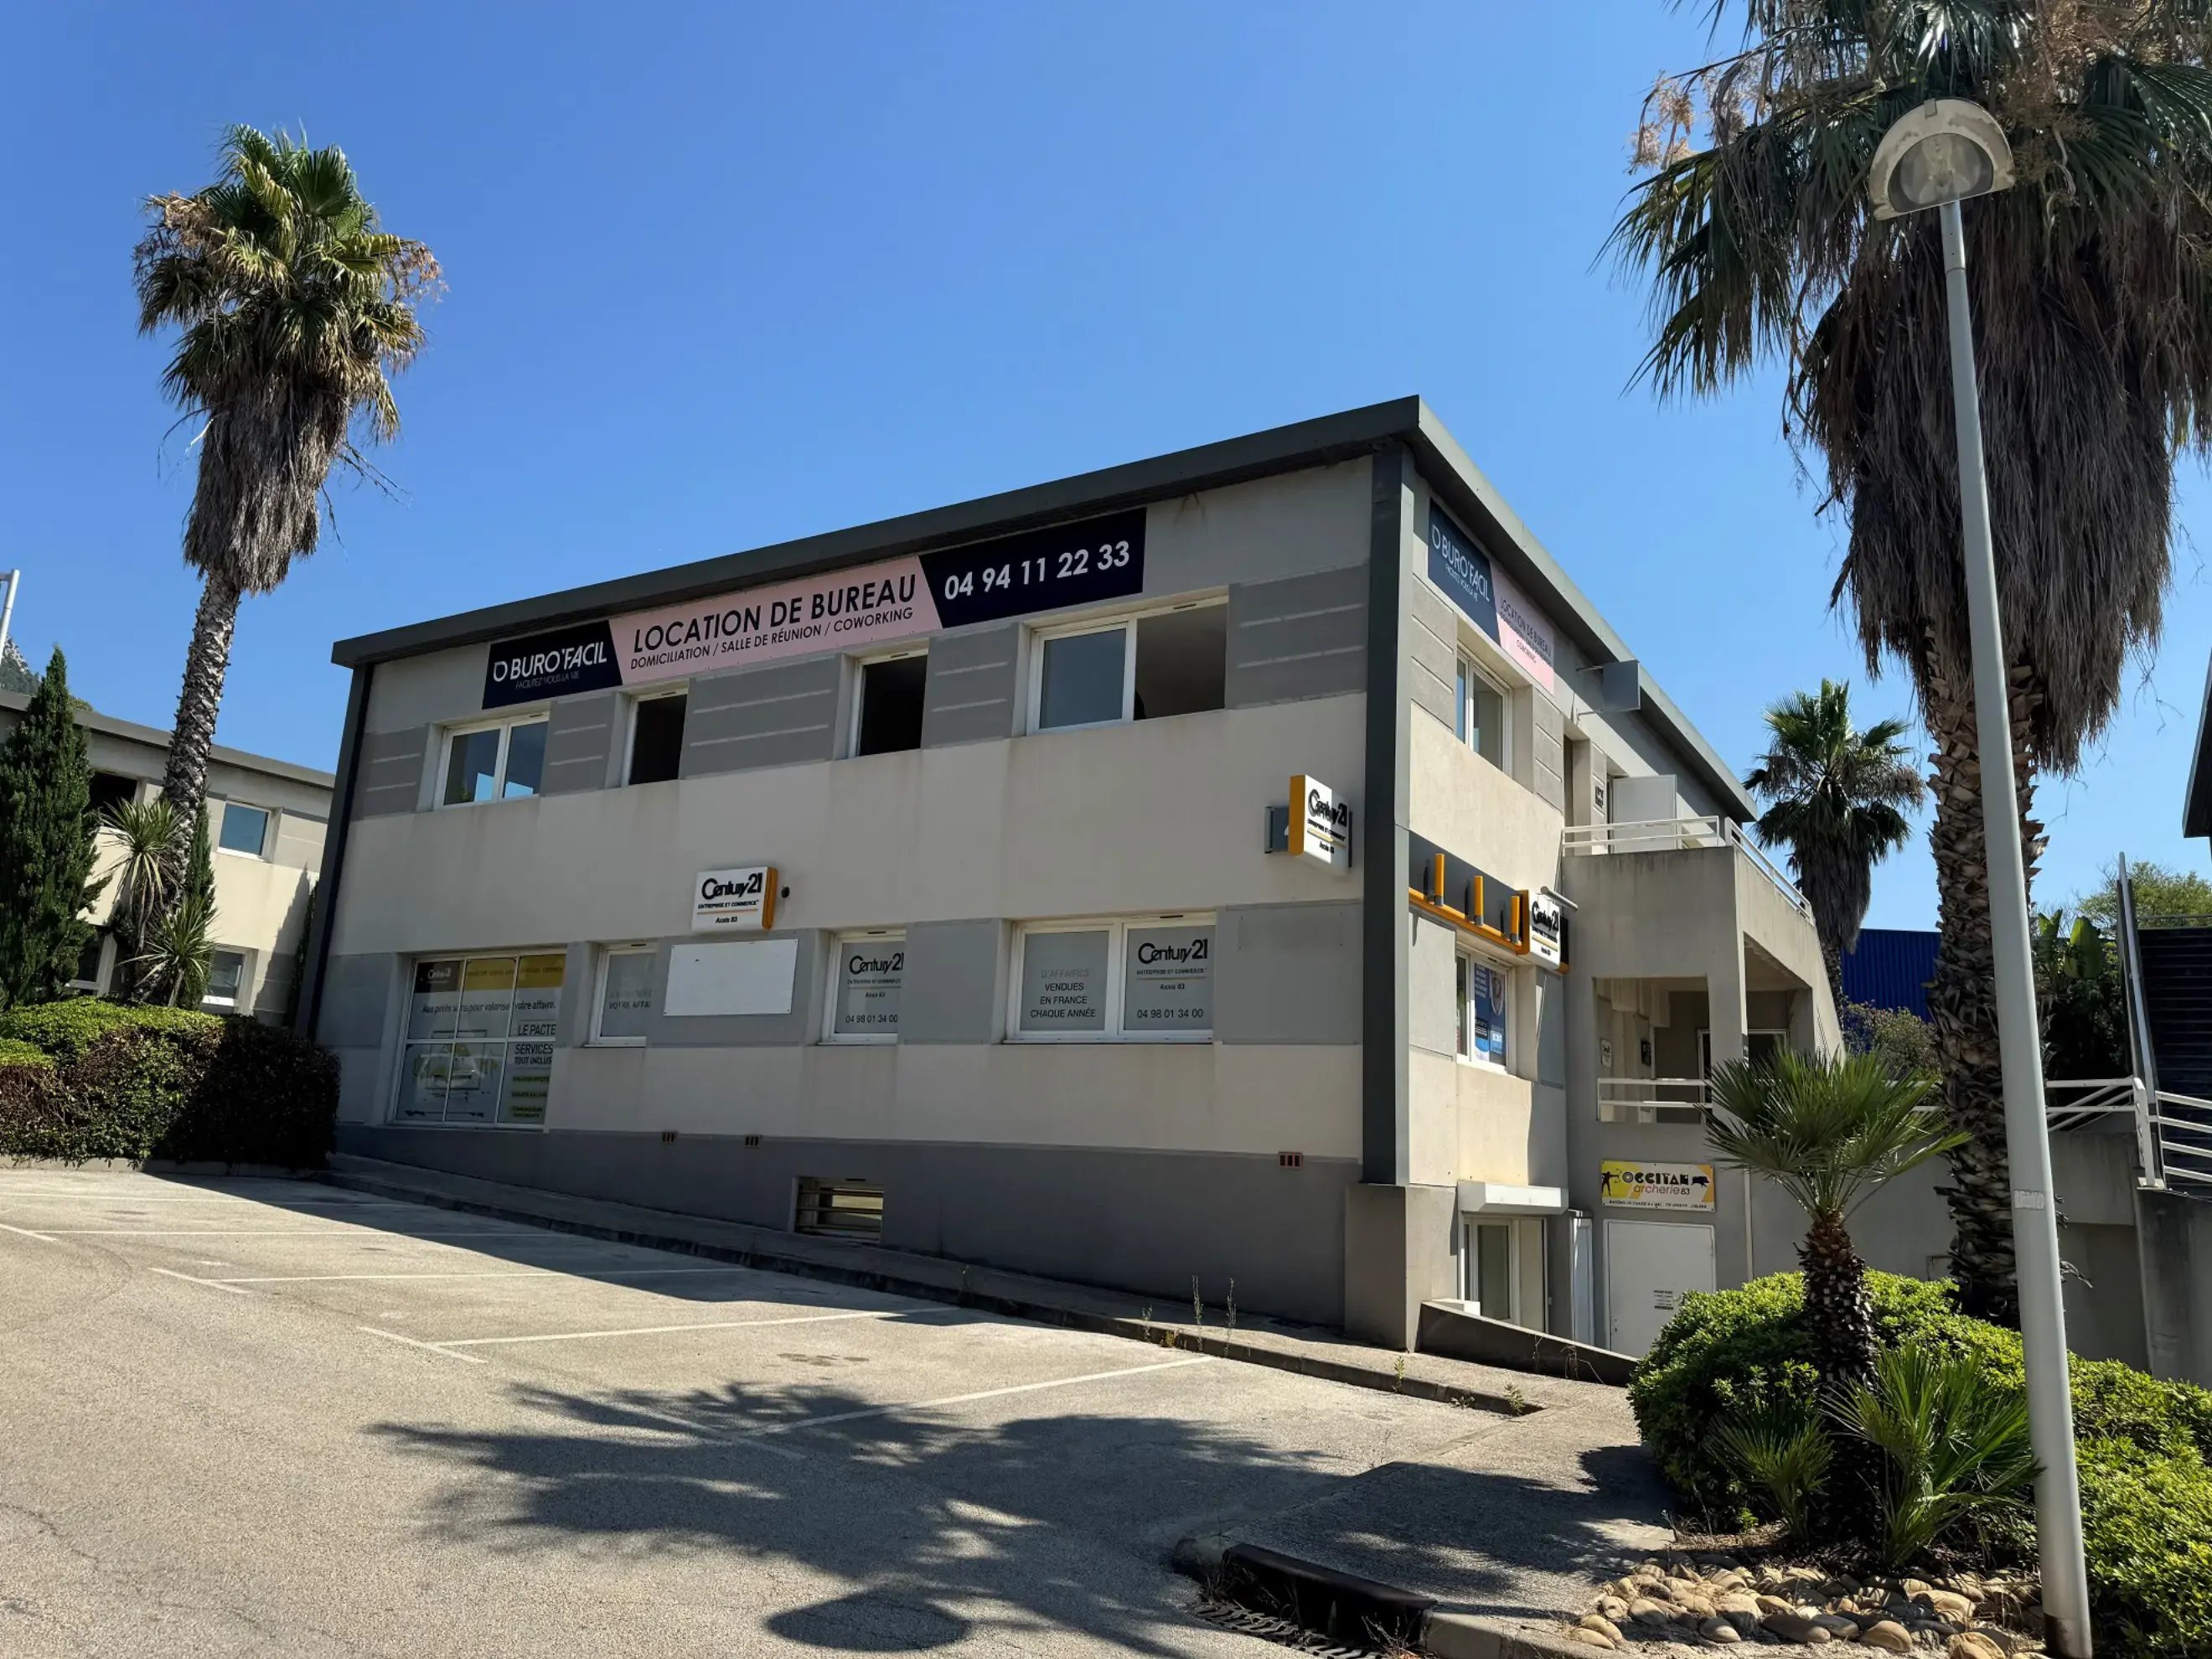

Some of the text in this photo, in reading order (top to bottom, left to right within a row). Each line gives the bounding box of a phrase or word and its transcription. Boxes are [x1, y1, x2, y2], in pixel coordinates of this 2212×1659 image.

[944, 540, 1129, 600] 04 94 11 22 33
[1442, 535, 1490, 602] BURO'FACIL
[634, 574, 916, 653] LOCATION DE BUREAU
[1501, 597, 1526, 632] LOCATION
[631, 607, 913, 669] DOMICILIATION / SALLE DE RÉUNION / COWORKING
[510, 641, 607, 680] BURO'FACIL
[1041, 969, 1089, 979] D'AFFAIRES
[1045, 983, 1084, 991] VENDUES
[1040, 995, 1088, 1004] EN FRANCE
[845, 1015, 855, 1023] 04
[866, 1014, 876, 1023] 01
[877, 1014, 886, 1023] 34
[889, 1013, 898, 1023] 00
[1031, 1007, 1096, 1020] CHAQUE ANNÉE
[1137, 1009, 1204, 1018] 04 98 01 34 00
[518, 1024, 557, 1036] LE PACTE
[515, 1044, 553, 1055] SERVICES
[514, 1056, 552, 1065] TOUT INCLUS
[1622, 1171, 1689, 1186] OCCITAN
[1634, 1184, 1680, 1195] archerie
